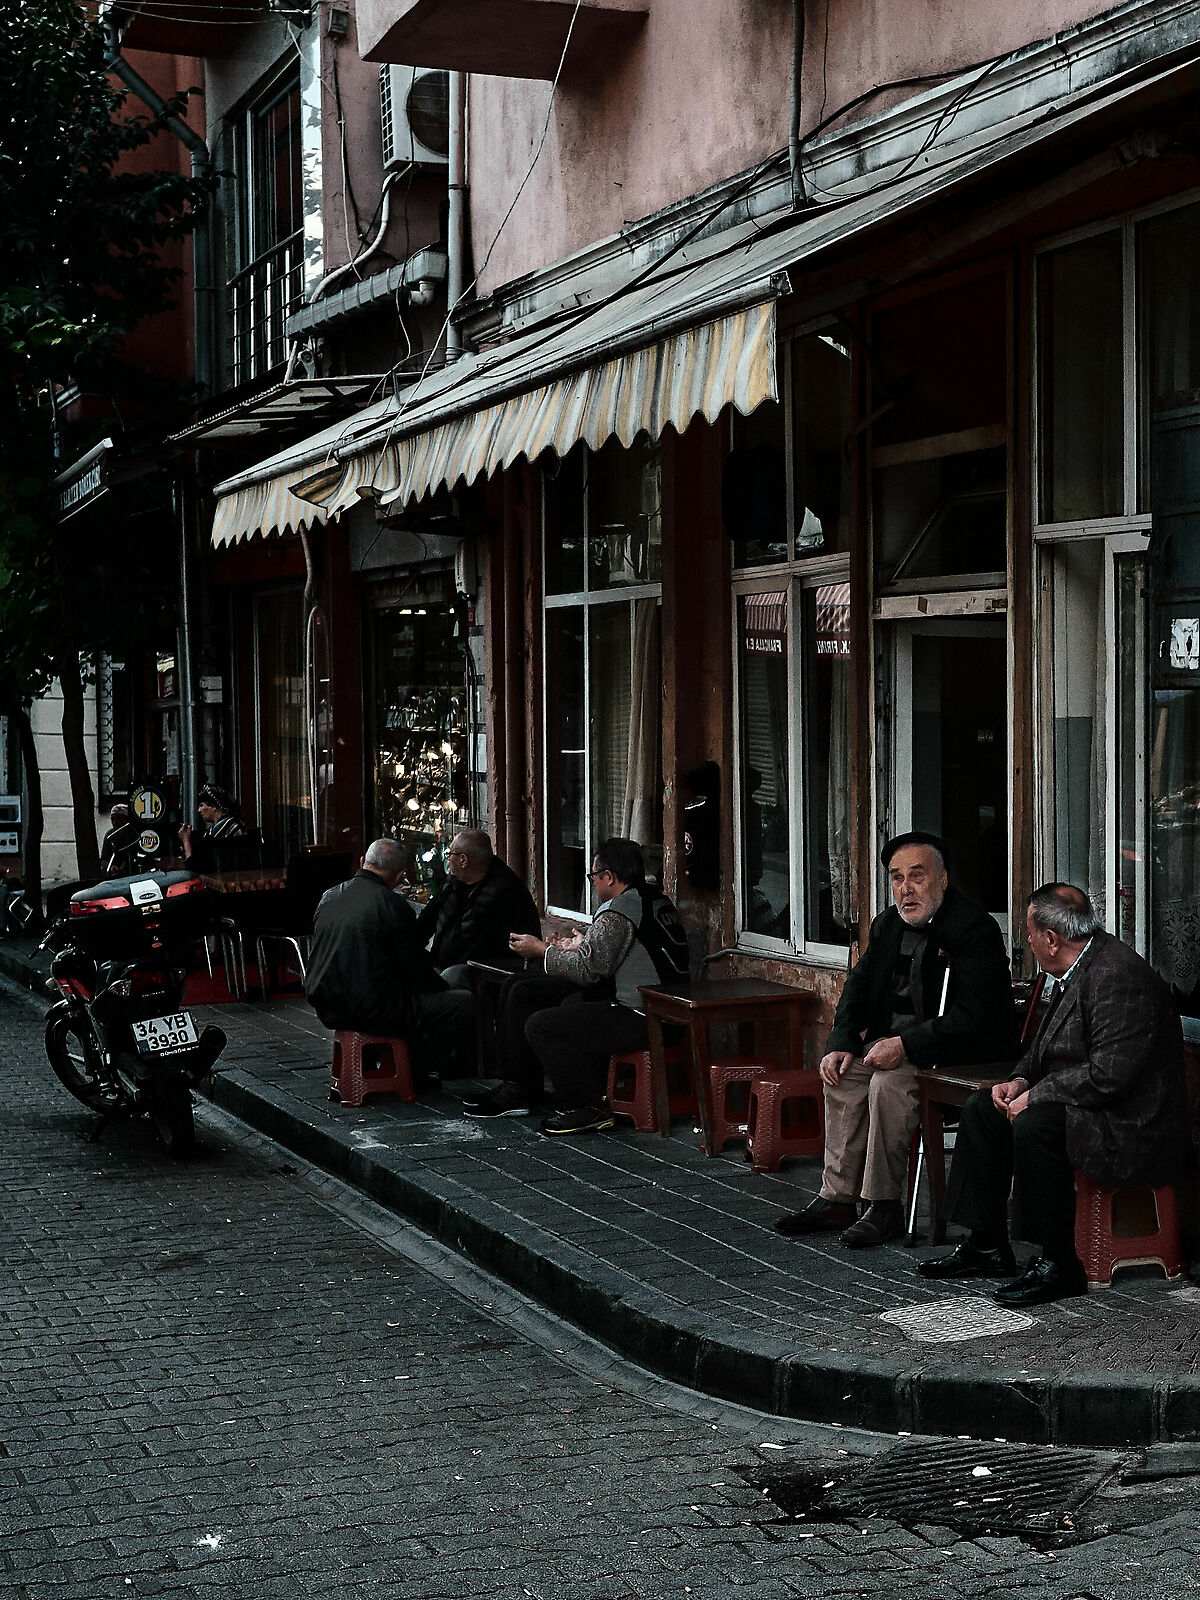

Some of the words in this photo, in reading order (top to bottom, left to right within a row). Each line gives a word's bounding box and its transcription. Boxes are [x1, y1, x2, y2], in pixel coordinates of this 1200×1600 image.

[136, 1021, 157, 1037] 34
[163, 1015, 187, 1031] YB
[149, 1030, 189, 1049] 3930
